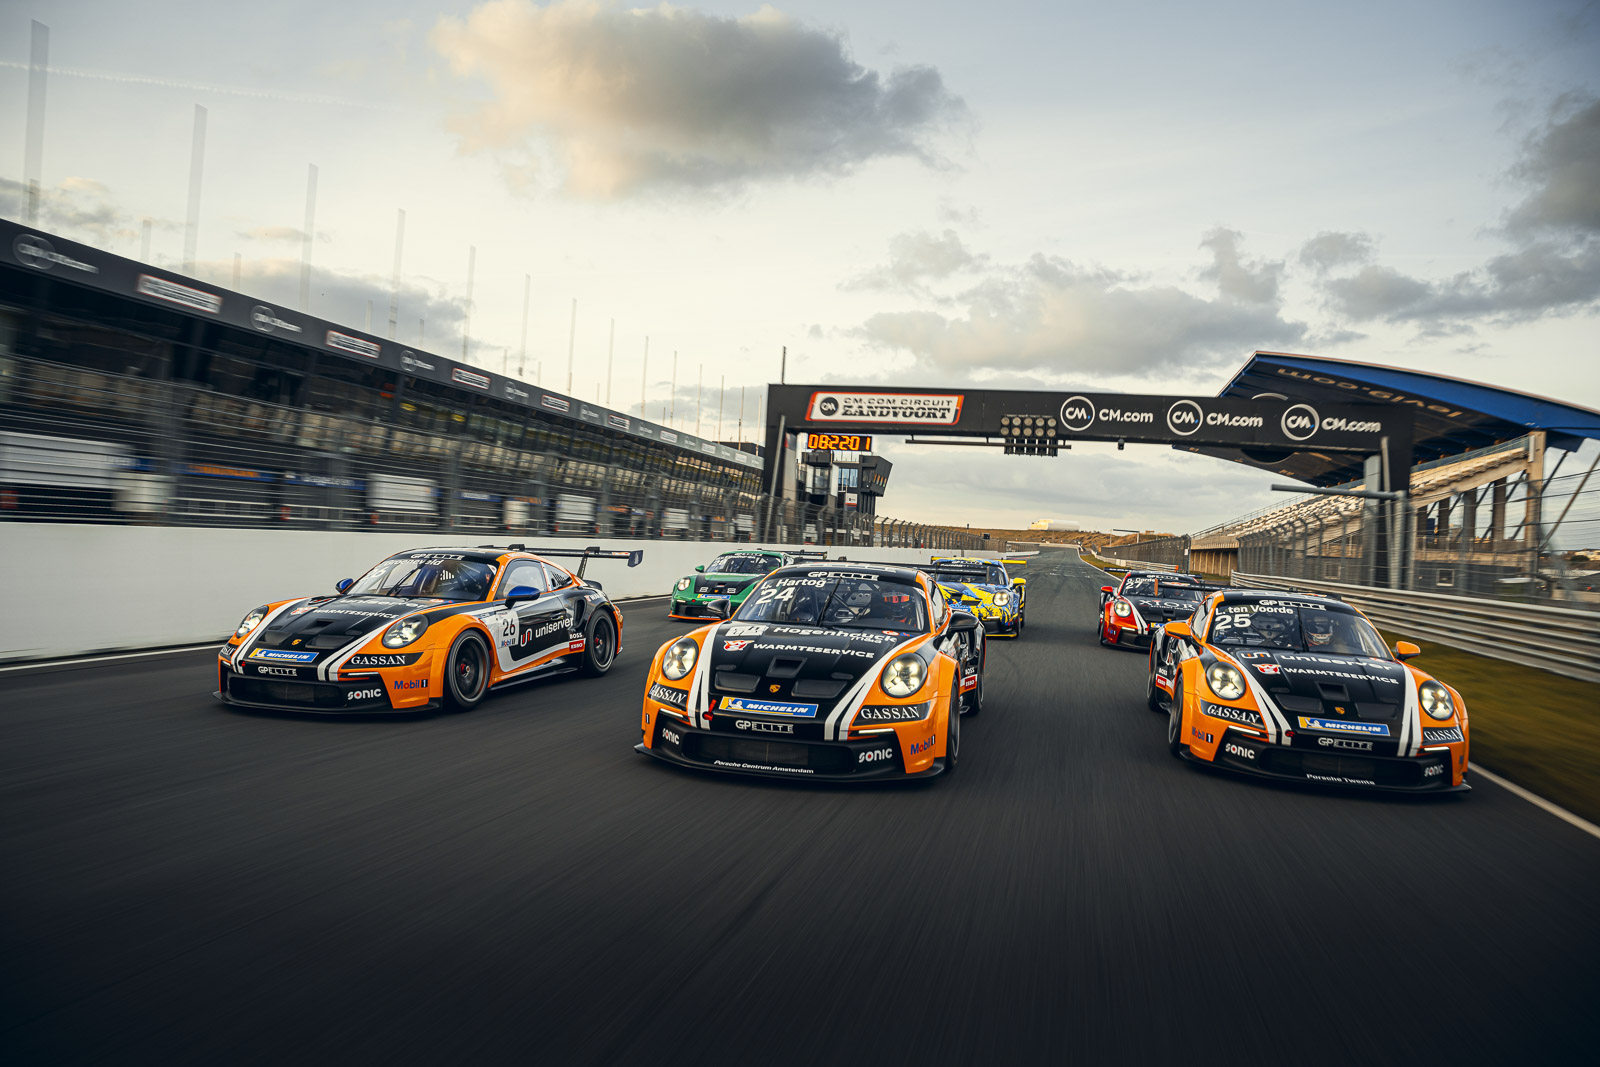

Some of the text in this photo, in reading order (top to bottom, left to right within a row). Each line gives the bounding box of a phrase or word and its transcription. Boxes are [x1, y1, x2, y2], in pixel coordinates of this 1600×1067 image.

[900, 398, 953, 407] CIRCUIT
[841, 405, 951, 419] ZANDVOORT
[1099, 408, 1154, 423] CM.com
[1206, 412, 1264, 428] CM.com
[1321, 417, 1382, 433] CM.com
[776, 578, 827, 588] Hartog
[1125, 581, 1143, 590] 27
[755, 587, 796, 605] 24
[1139, 600, 1196, 610] XTOR
[1215, 605, 1294, 616] L. ten Voorde
[313, 609, 401, 619] WARMTESERVICE
[502, 618, 516, 637] 26
[535, 617, 574, 638] uniserver
[1214, 614, 1252, 630] 25
[569, 632, 583, 640] BOSS
[266, 652, 310, 660] MICHELIN
[753, 643, 875, 659] WARMTESERVICE
[350, 655, 406, 665] GASSAN
[1280, 654, 1393, 671] uniserver
[1284, 667, 1400, 684] WARMTESERVICE
[394, 680, 420, 690] Mobil
[746, 703, 809, 713] MICHELIN
[860, 706, 920, 720] GASSAN
[1207, 704, 1260, 724] GASSAN
[1325, 722, 1382, 732] MICHELIN
[910, 737, 931, 755] Mobil
[713, 759, 814, 774] Porsche Centrum Amsterdam
[1306, 773, 1342, 782] Porsche
